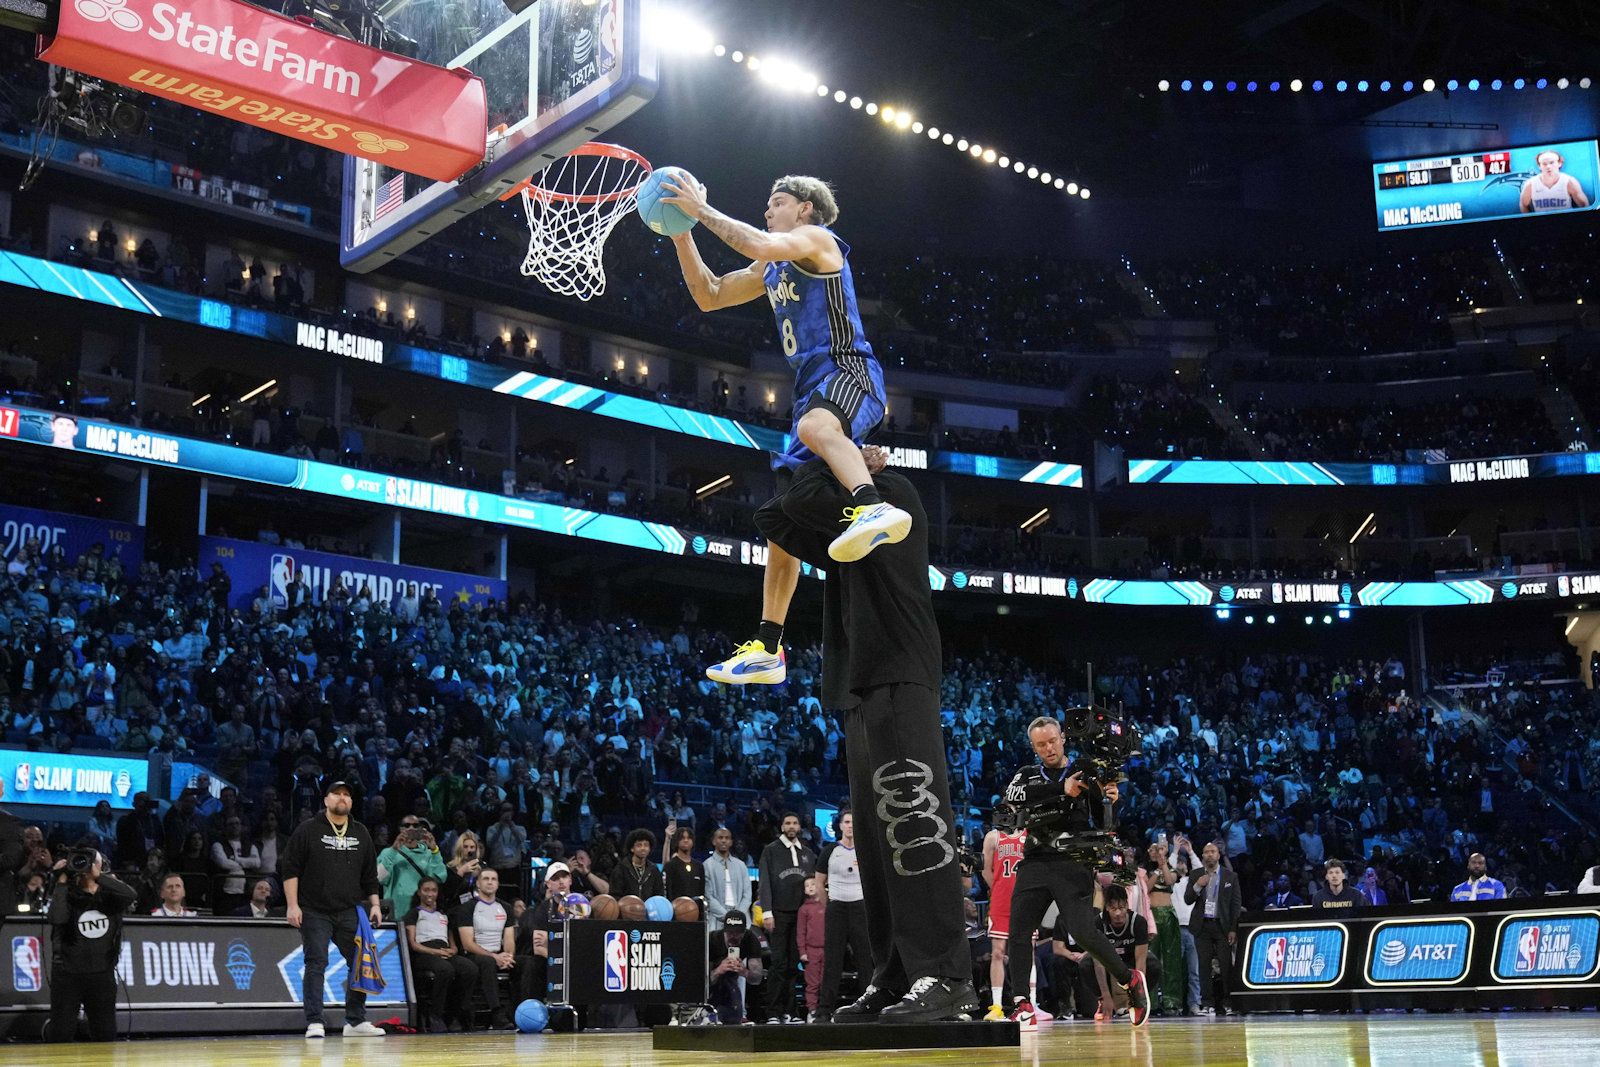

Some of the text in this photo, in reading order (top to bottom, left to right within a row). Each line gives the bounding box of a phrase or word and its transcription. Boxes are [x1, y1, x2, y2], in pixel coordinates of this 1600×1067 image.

[1410, 171, 1428, 185] 50.0
[1457, 165, 1480, 181] 50.0
[1384, 203, 1462, 226] MAC McCLUNG
[296, 322, 325, 351] MAC
[327, 329, 384, 364] McCLUNG
[782, 318, 797, 357] 8
[86, 425, 179, 463] MAC McCLUNG
[1450, 462, 1476, 483] MAC
[1477, 458, 1529, 481] McCLUNG
[356, 479, 467, 516] AT&T SLAM DUNK
[215, 546, 235, 558] 104
[707, 541, 733, 557] AT&T
[474, 583, 491, 595] 104
[968, 575, 1067, 597] AT&T SLAM DUNK
[1236, 584, 1340, 602] AT&T SLAM DUNK
[1519, 582, 1548, 595] AT&T
[33, 765, 114, 794] SLAM DUNK
[79, 918, 109, 932] TNT
[1553, 924, 1572, 933] AT&T
[641, 932, 661, 941] AT&T
[1540, 934, 1571, 953] SLAM
[630, 943, 661, 967] SLAM
[1287, 944, 1315, 961] SLAM
[1409, 943, 1457, 961] AT&T
[142, 941, 220, 986] DUNK
[1285, 961, 1312, 977] DUNK
[1537, 952, 1568, 971] DUNK
[630, 967, 661, 991] DUNK
